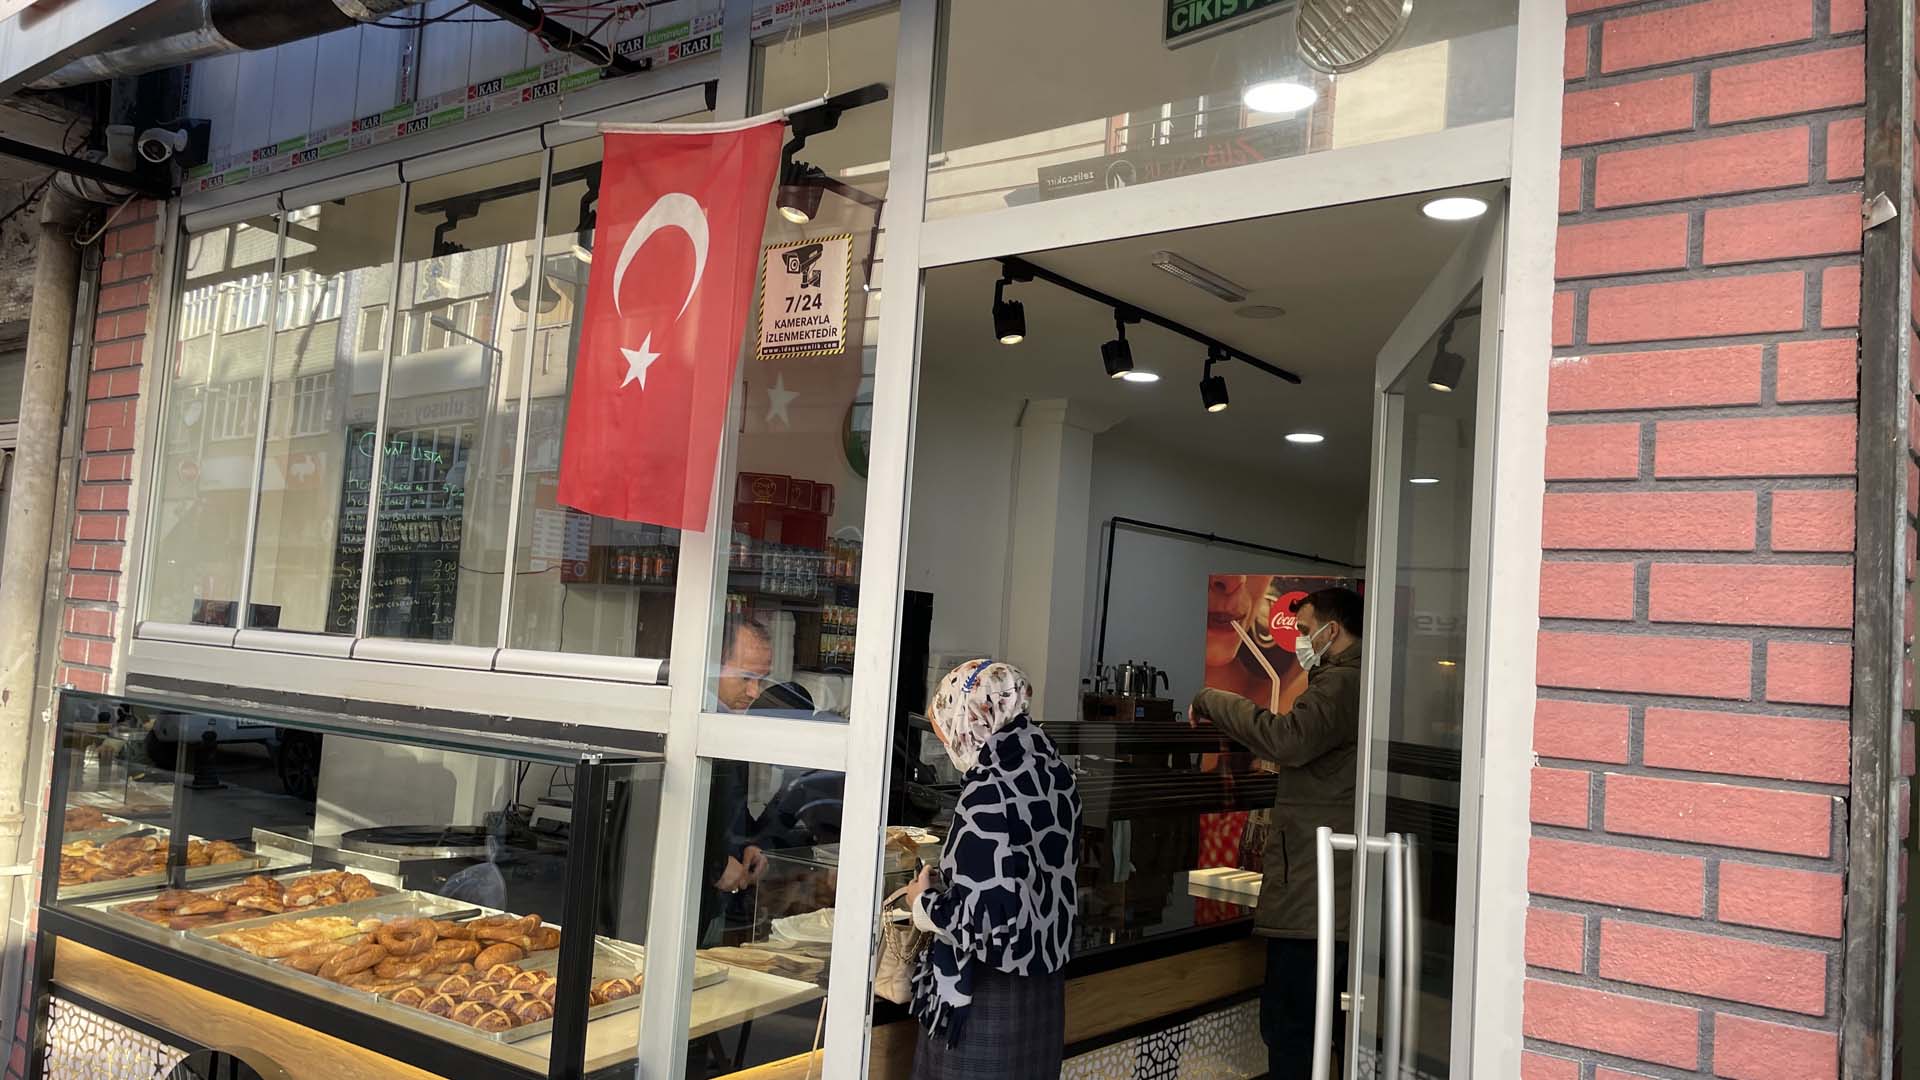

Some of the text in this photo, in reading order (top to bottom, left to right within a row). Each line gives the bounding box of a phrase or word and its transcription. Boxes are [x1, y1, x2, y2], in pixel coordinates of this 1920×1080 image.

[617, 37, 642, 55] KAR
[682, 38, 709, 57] KAR
[478, 80, 501, 97] KAR
[533, 81, 557, 99] KAR
[361, 115, 380, 130] KAR
[408, 119, 427, 133] KAR
[261, 145, 278, 160] KAR
[300, 150, 318, 163] KAR
[207, 175, 223, 189] KAR
[785, 293, 822, 313] 7/24
[774, 313, 830, 329] KAMERAYLA
[765, 325, 838, 343] İZLENMEKTEDİR
